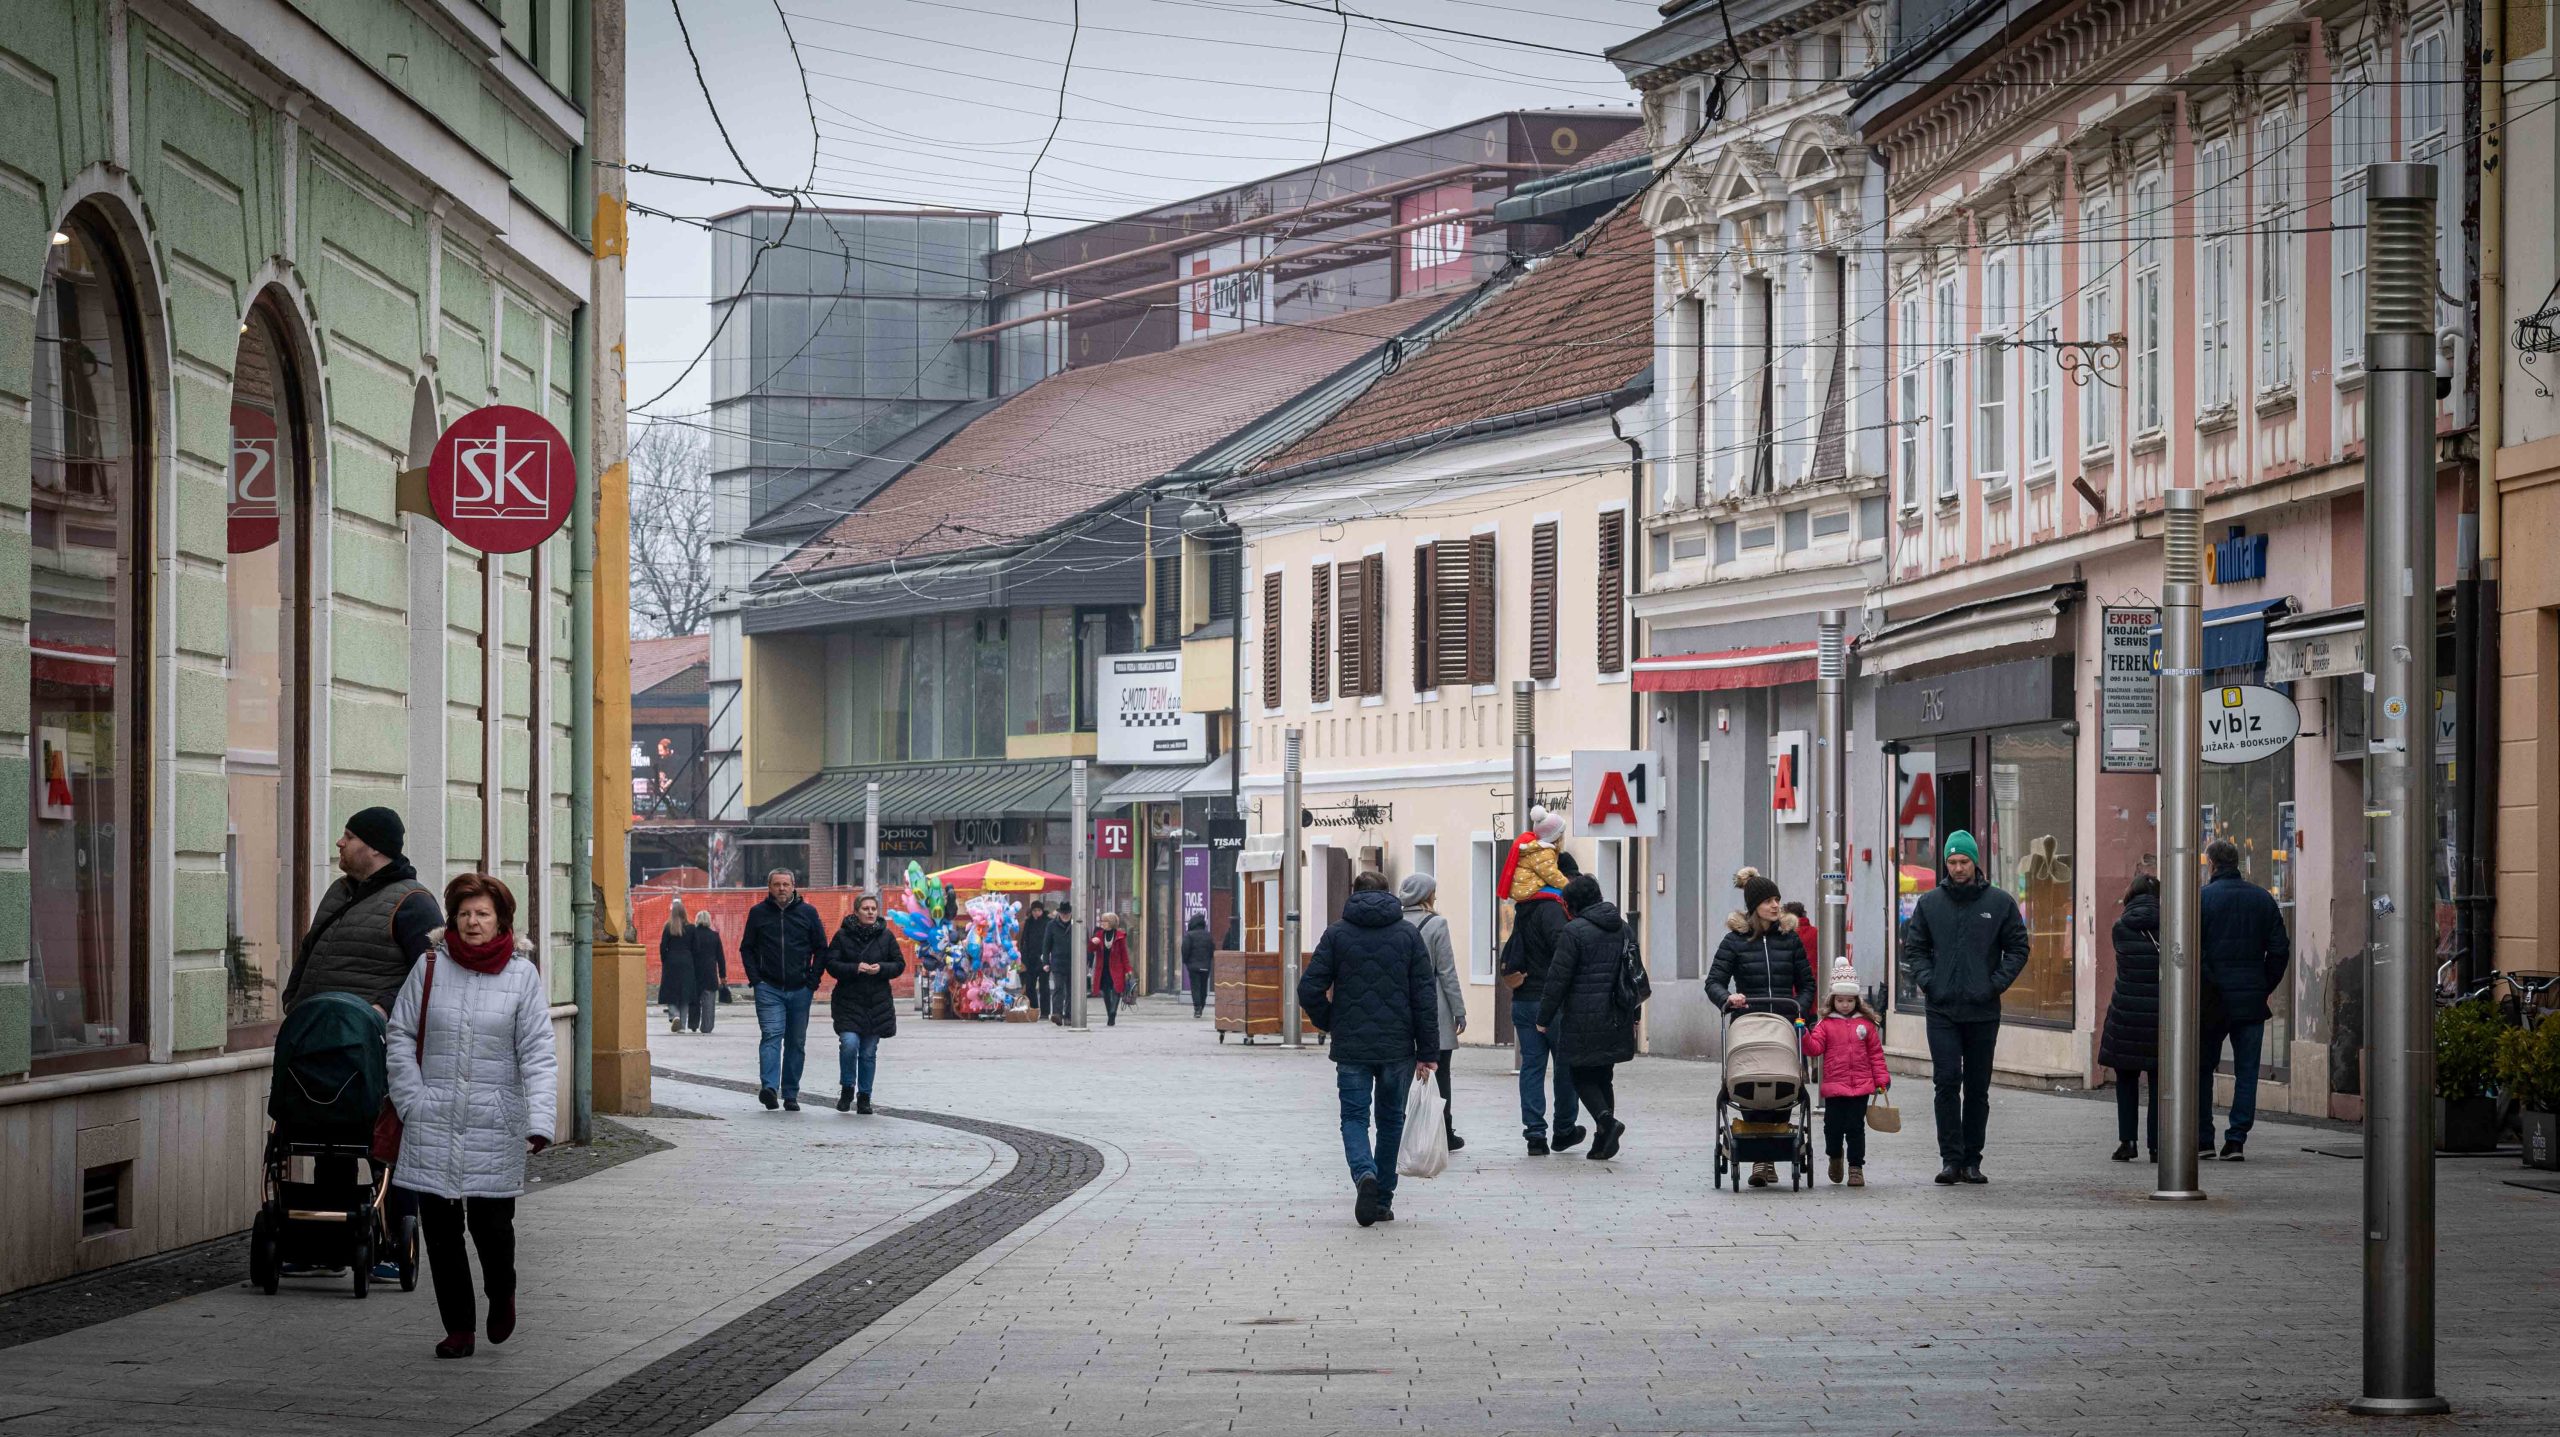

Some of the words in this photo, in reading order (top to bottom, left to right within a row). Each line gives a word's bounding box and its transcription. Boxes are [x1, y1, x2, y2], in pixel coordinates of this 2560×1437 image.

[1411, 208, 1465, 271] NKD
[2216, 526, 2268, 584] mlinar
[2109, 613, 2152, 625] EXPRES
[2106, 625, 2152, 636] KROJAČ
[2114, 637, 2149, 647] SERVIS
[1149, 686, 1167, 710] TEAM
[2240, 736, 2288, 748] BOOKSHOP
[1588, 764, 1646, 825] A1
[879, 841, 928, 851] INETA
[1213, 838, 1242, 847] TISAK
[1184, 892, 1203, 907] TVOJE
